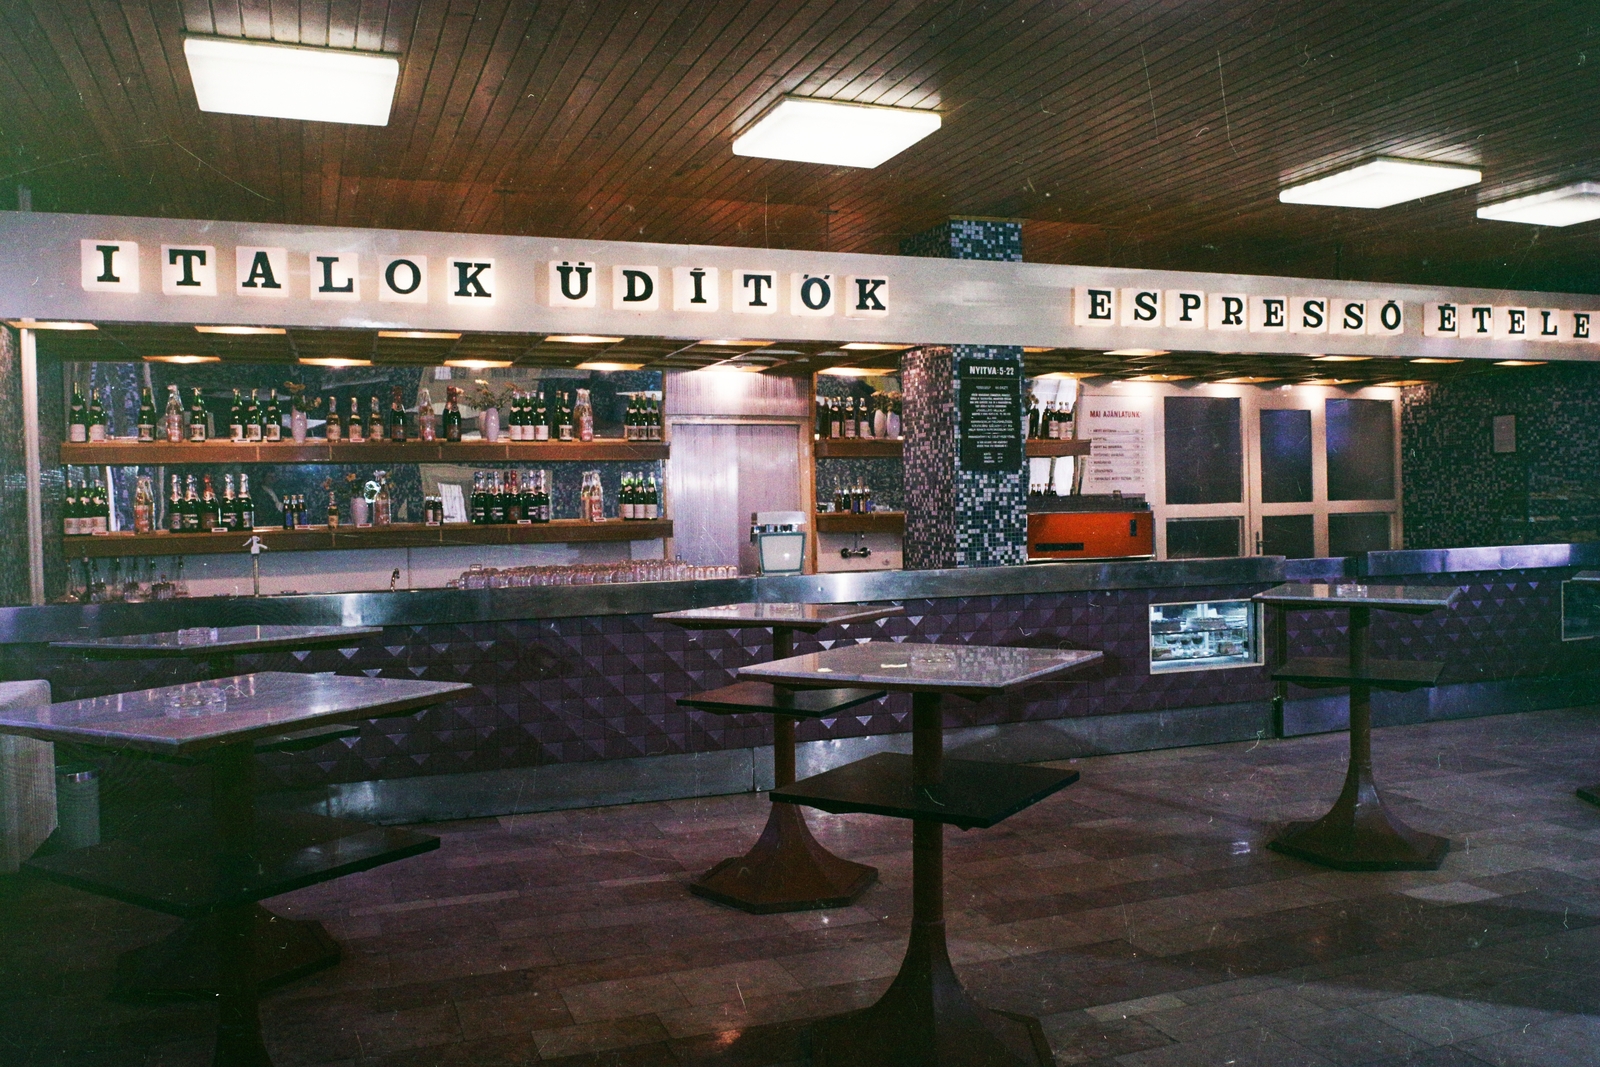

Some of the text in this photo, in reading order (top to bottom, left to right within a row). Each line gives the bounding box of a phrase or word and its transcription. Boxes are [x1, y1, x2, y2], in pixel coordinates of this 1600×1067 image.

[96, 244, 887, 312] ITALOK ÜDÍTŐK
[1089, 410, 1101, 418] MAI
